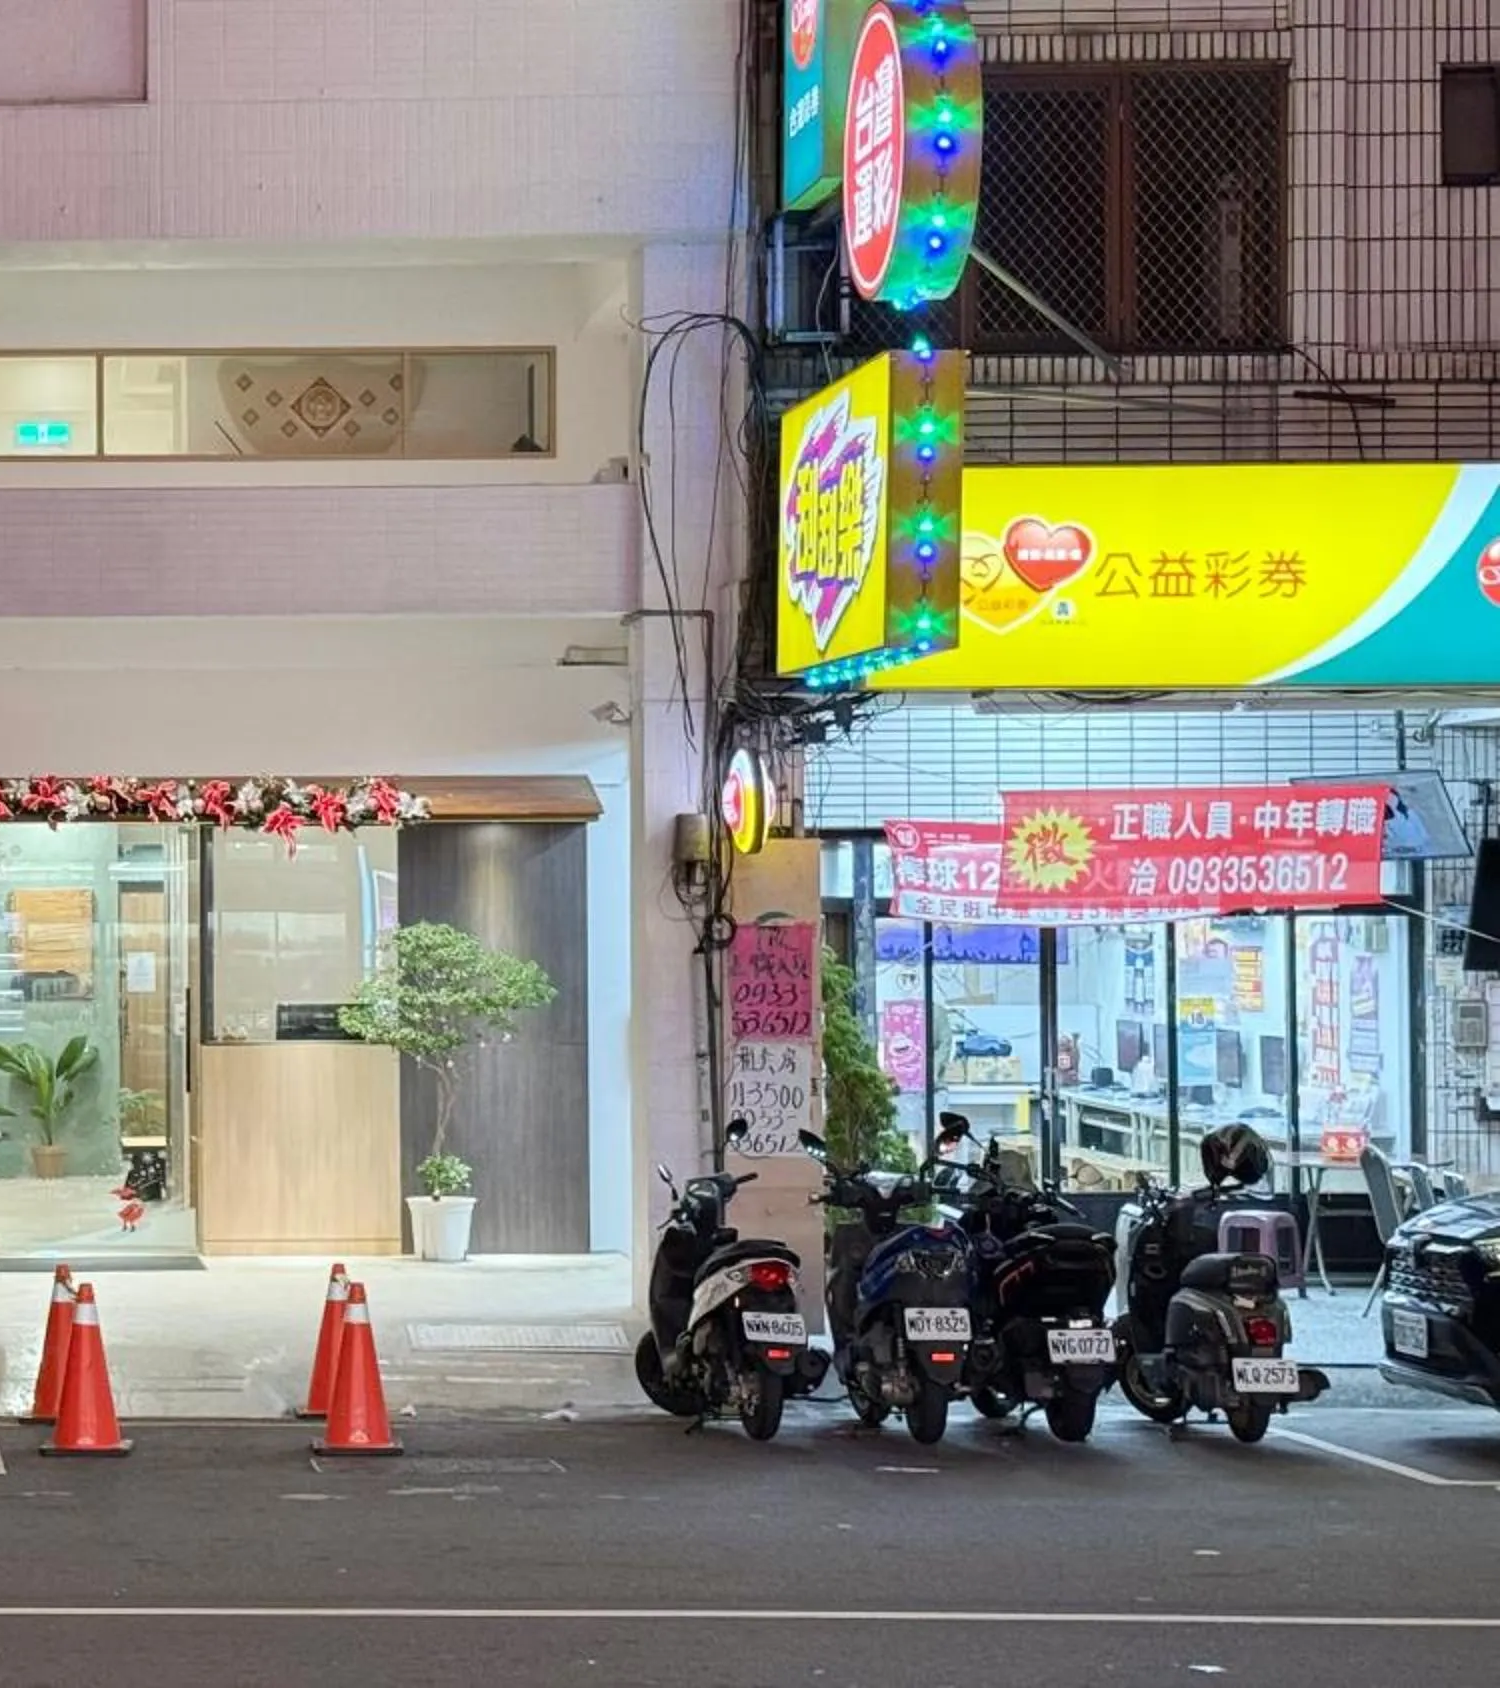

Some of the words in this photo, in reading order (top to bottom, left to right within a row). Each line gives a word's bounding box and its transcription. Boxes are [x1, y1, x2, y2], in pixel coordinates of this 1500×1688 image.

[1095, 550, 1307, 599] 公益彩券
[1110, 801, 1233, 841] 正職人員
[1024, 821, 1080, 873] 徵
[1167, 853, 1349, 894] 0933536512
